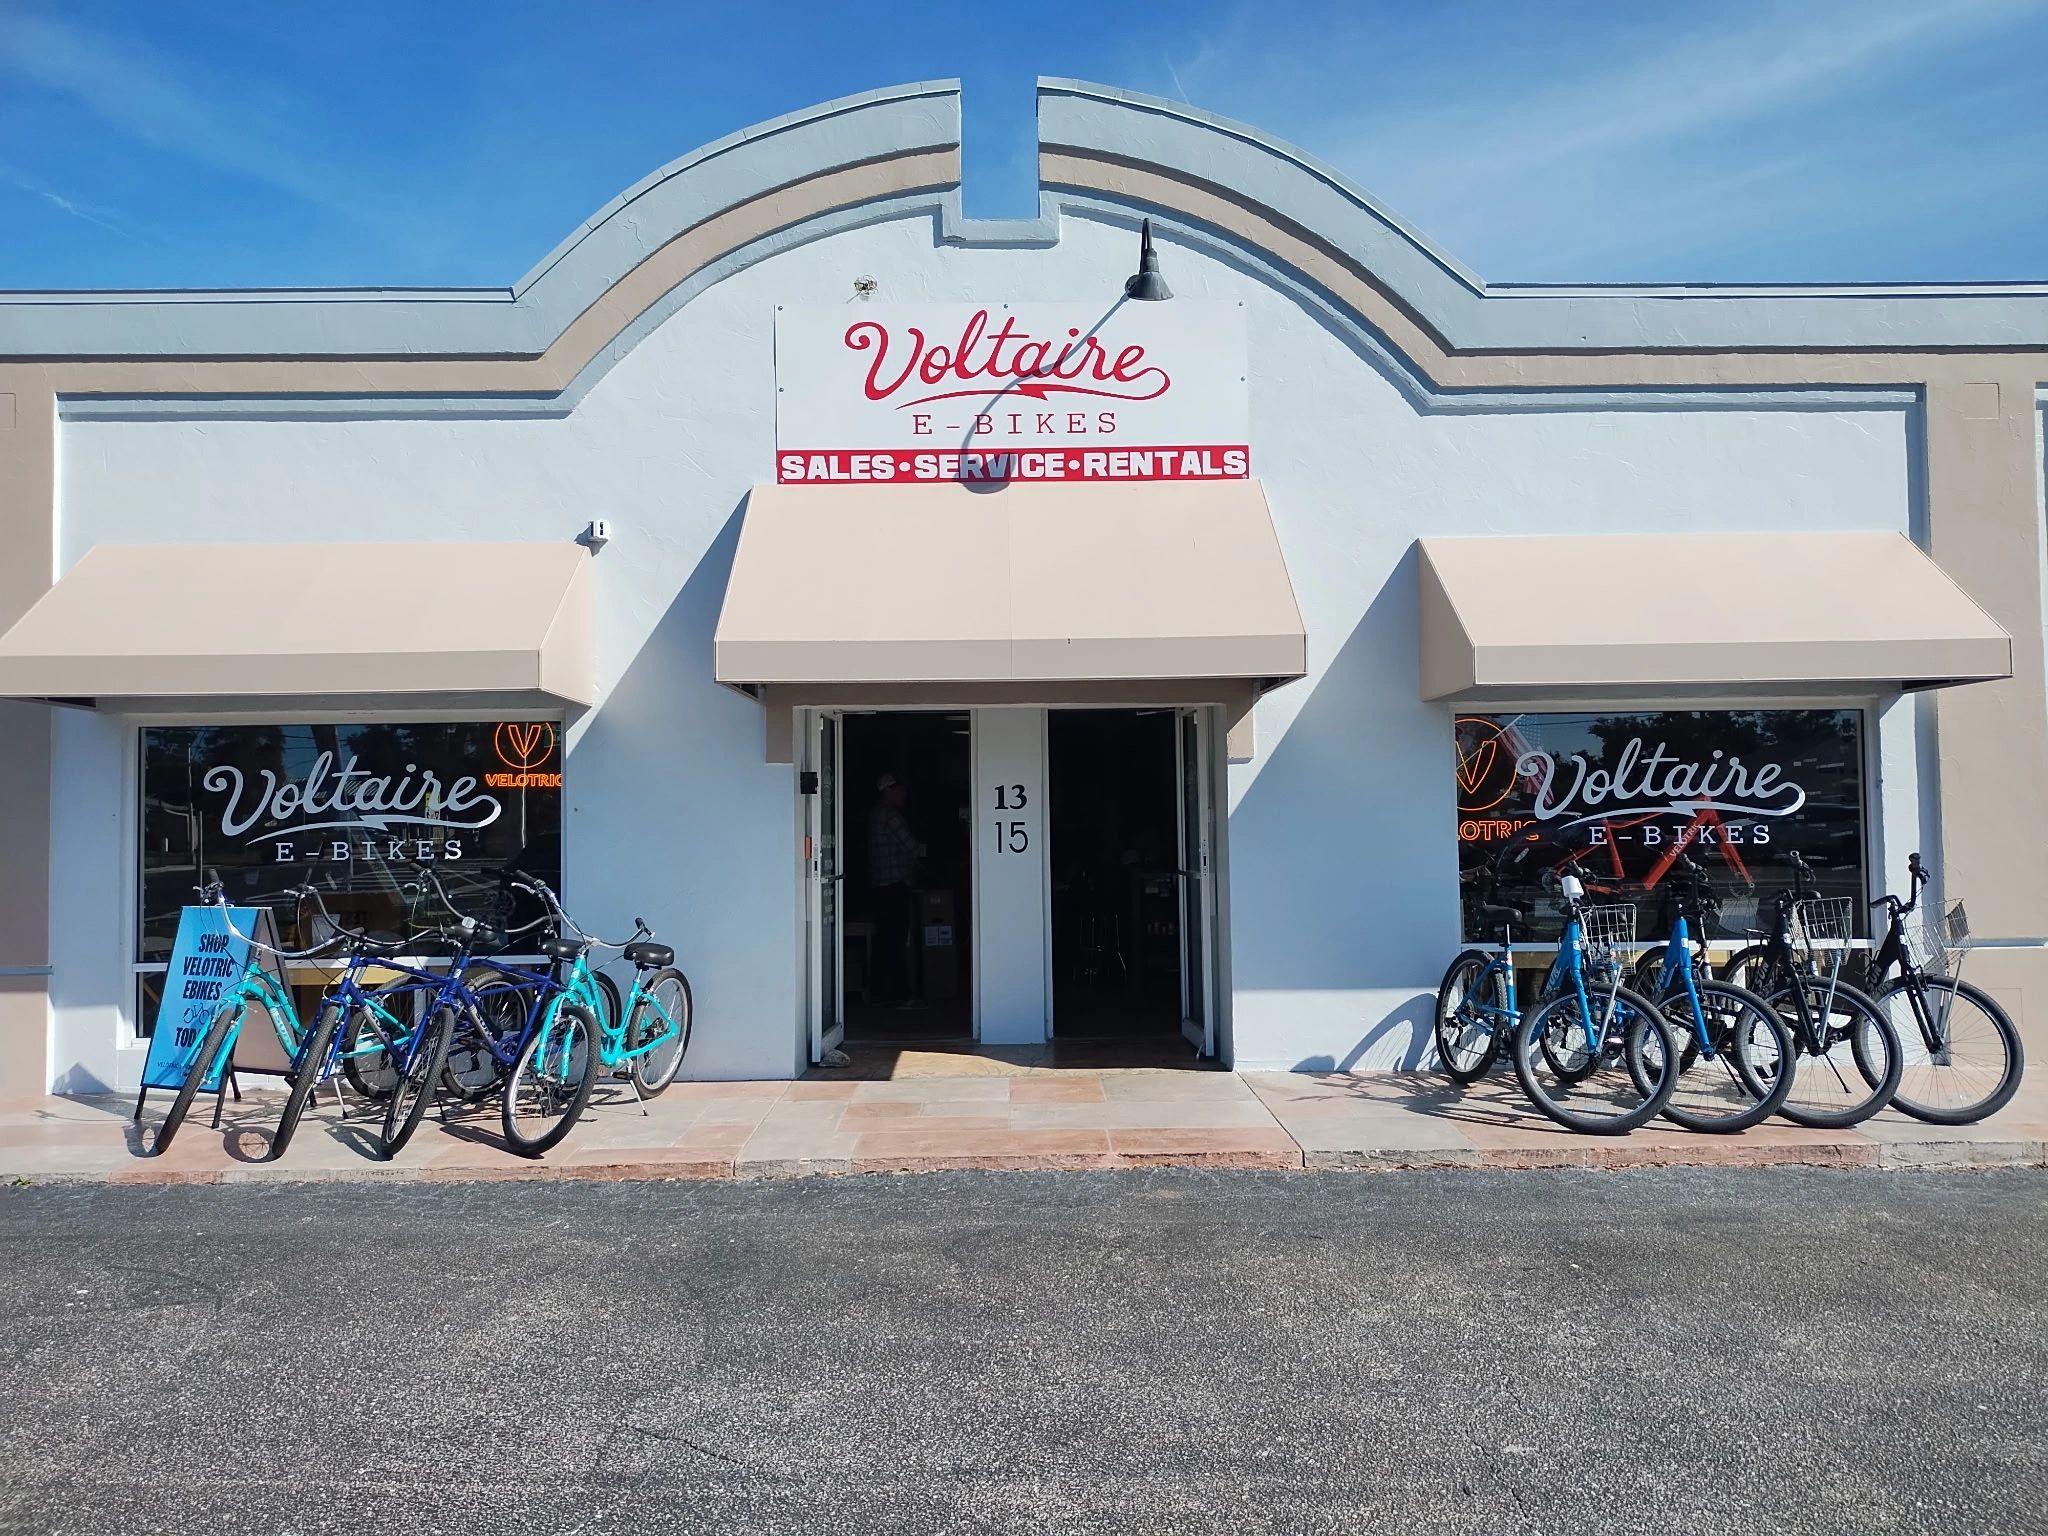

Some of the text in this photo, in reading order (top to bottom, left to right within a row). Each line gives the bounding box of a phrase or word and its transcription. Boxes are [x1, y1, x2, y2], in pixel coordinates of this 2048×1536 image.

[845, 309, 1171, 403] Voltaire
[914, 413, 1115, 435] E-BIKES
[1515, 737, 1806, 823] Voltaire
[203, 750, 501, 839] Voltaire
[994, 784, 1028, 810] 13
[994, 821, 1029, 854] 15
[1589, 825, 1770, 848] E-BIKES
[275, 839, 462, 862] E-BIKES
[198, 933, 230, 954] SHOP
[183, 956, 235, 977] VELOTRIC
[182, 979, 223, 1001] EBIKES
[174, 1026, 202, 1048] TOD
